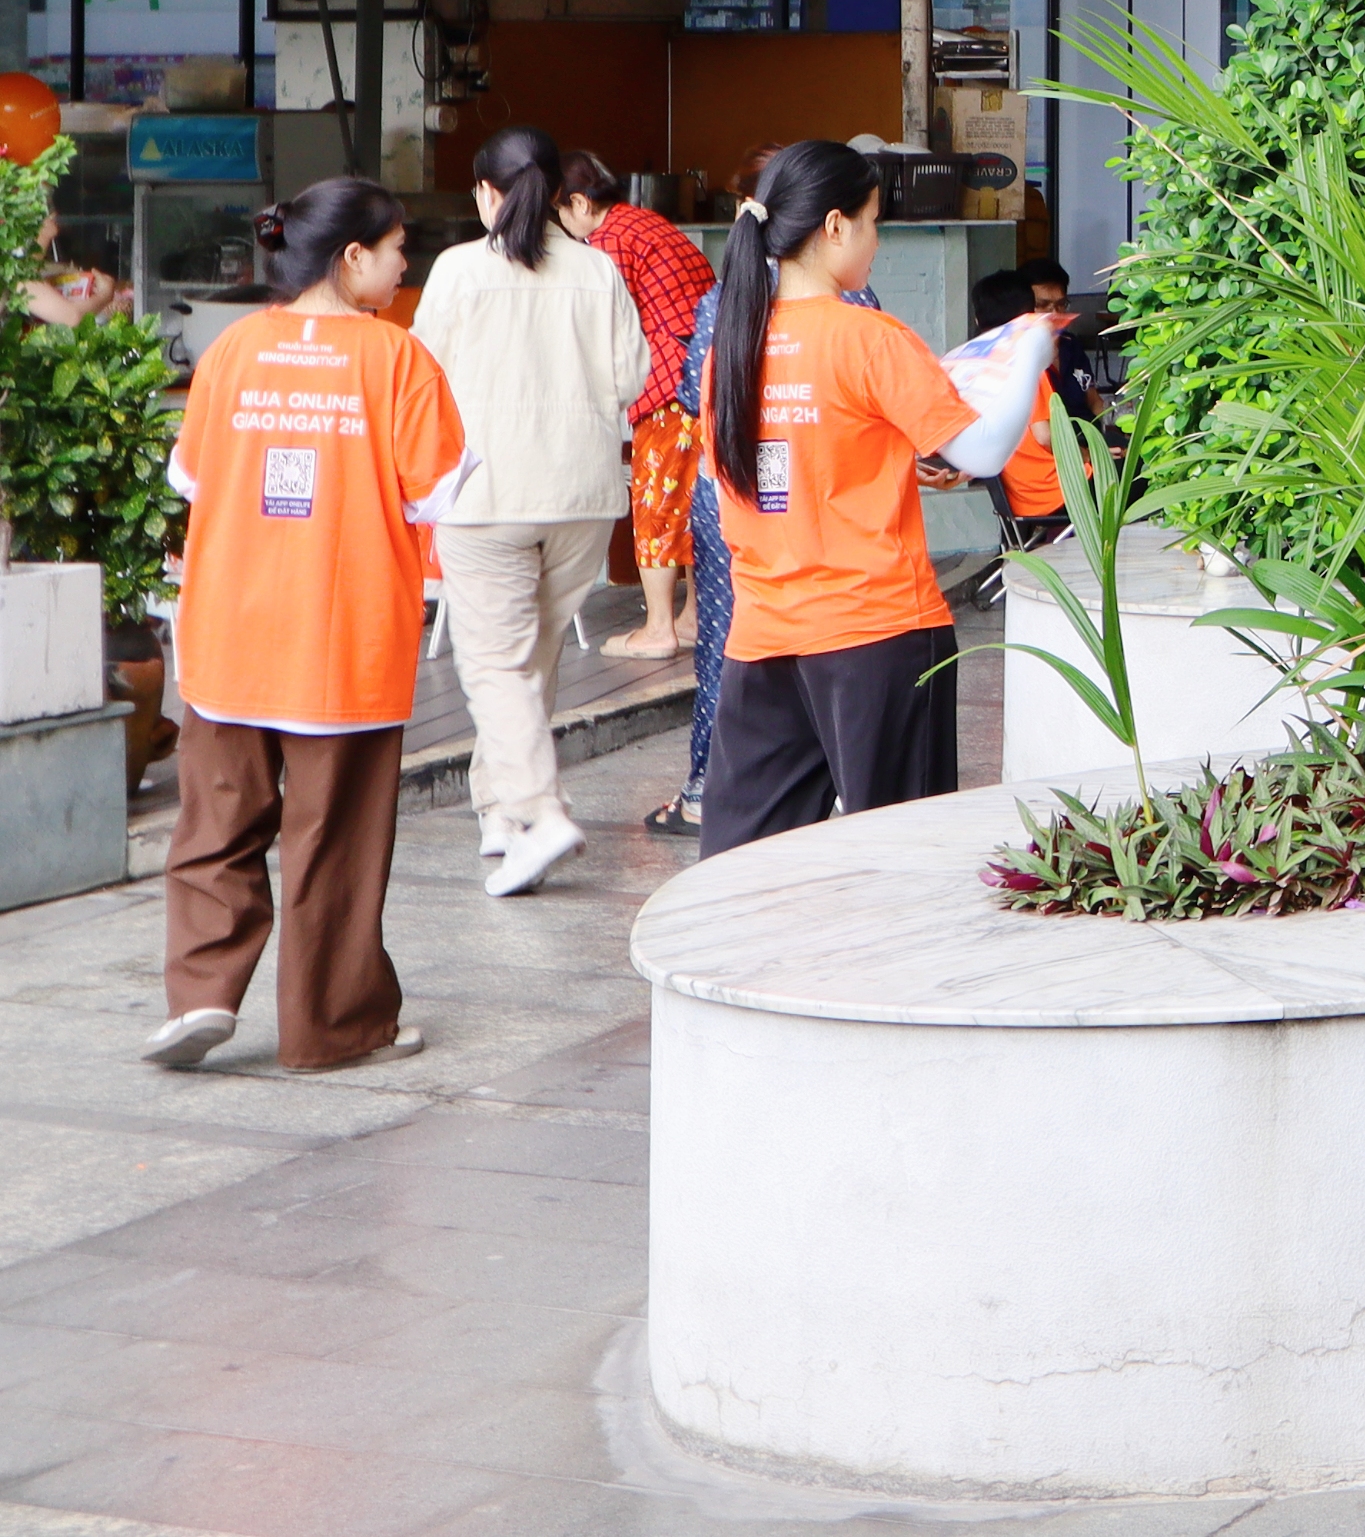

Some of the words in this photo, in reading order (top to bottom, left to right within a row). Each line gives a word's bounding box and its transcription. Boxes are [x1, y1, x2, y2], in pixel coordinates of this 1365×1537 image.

[162, 138, 244, 158] ALASKA
[240, 390, 281, 408] MUA
[288, 392, 360, 413] ONLINE
[232, 412, 275, 430] GIAO
[279, 414, 334, 434] NGAY
[338, 416, 365, 436] 2H
[793, 407, 818, 424] 2H
